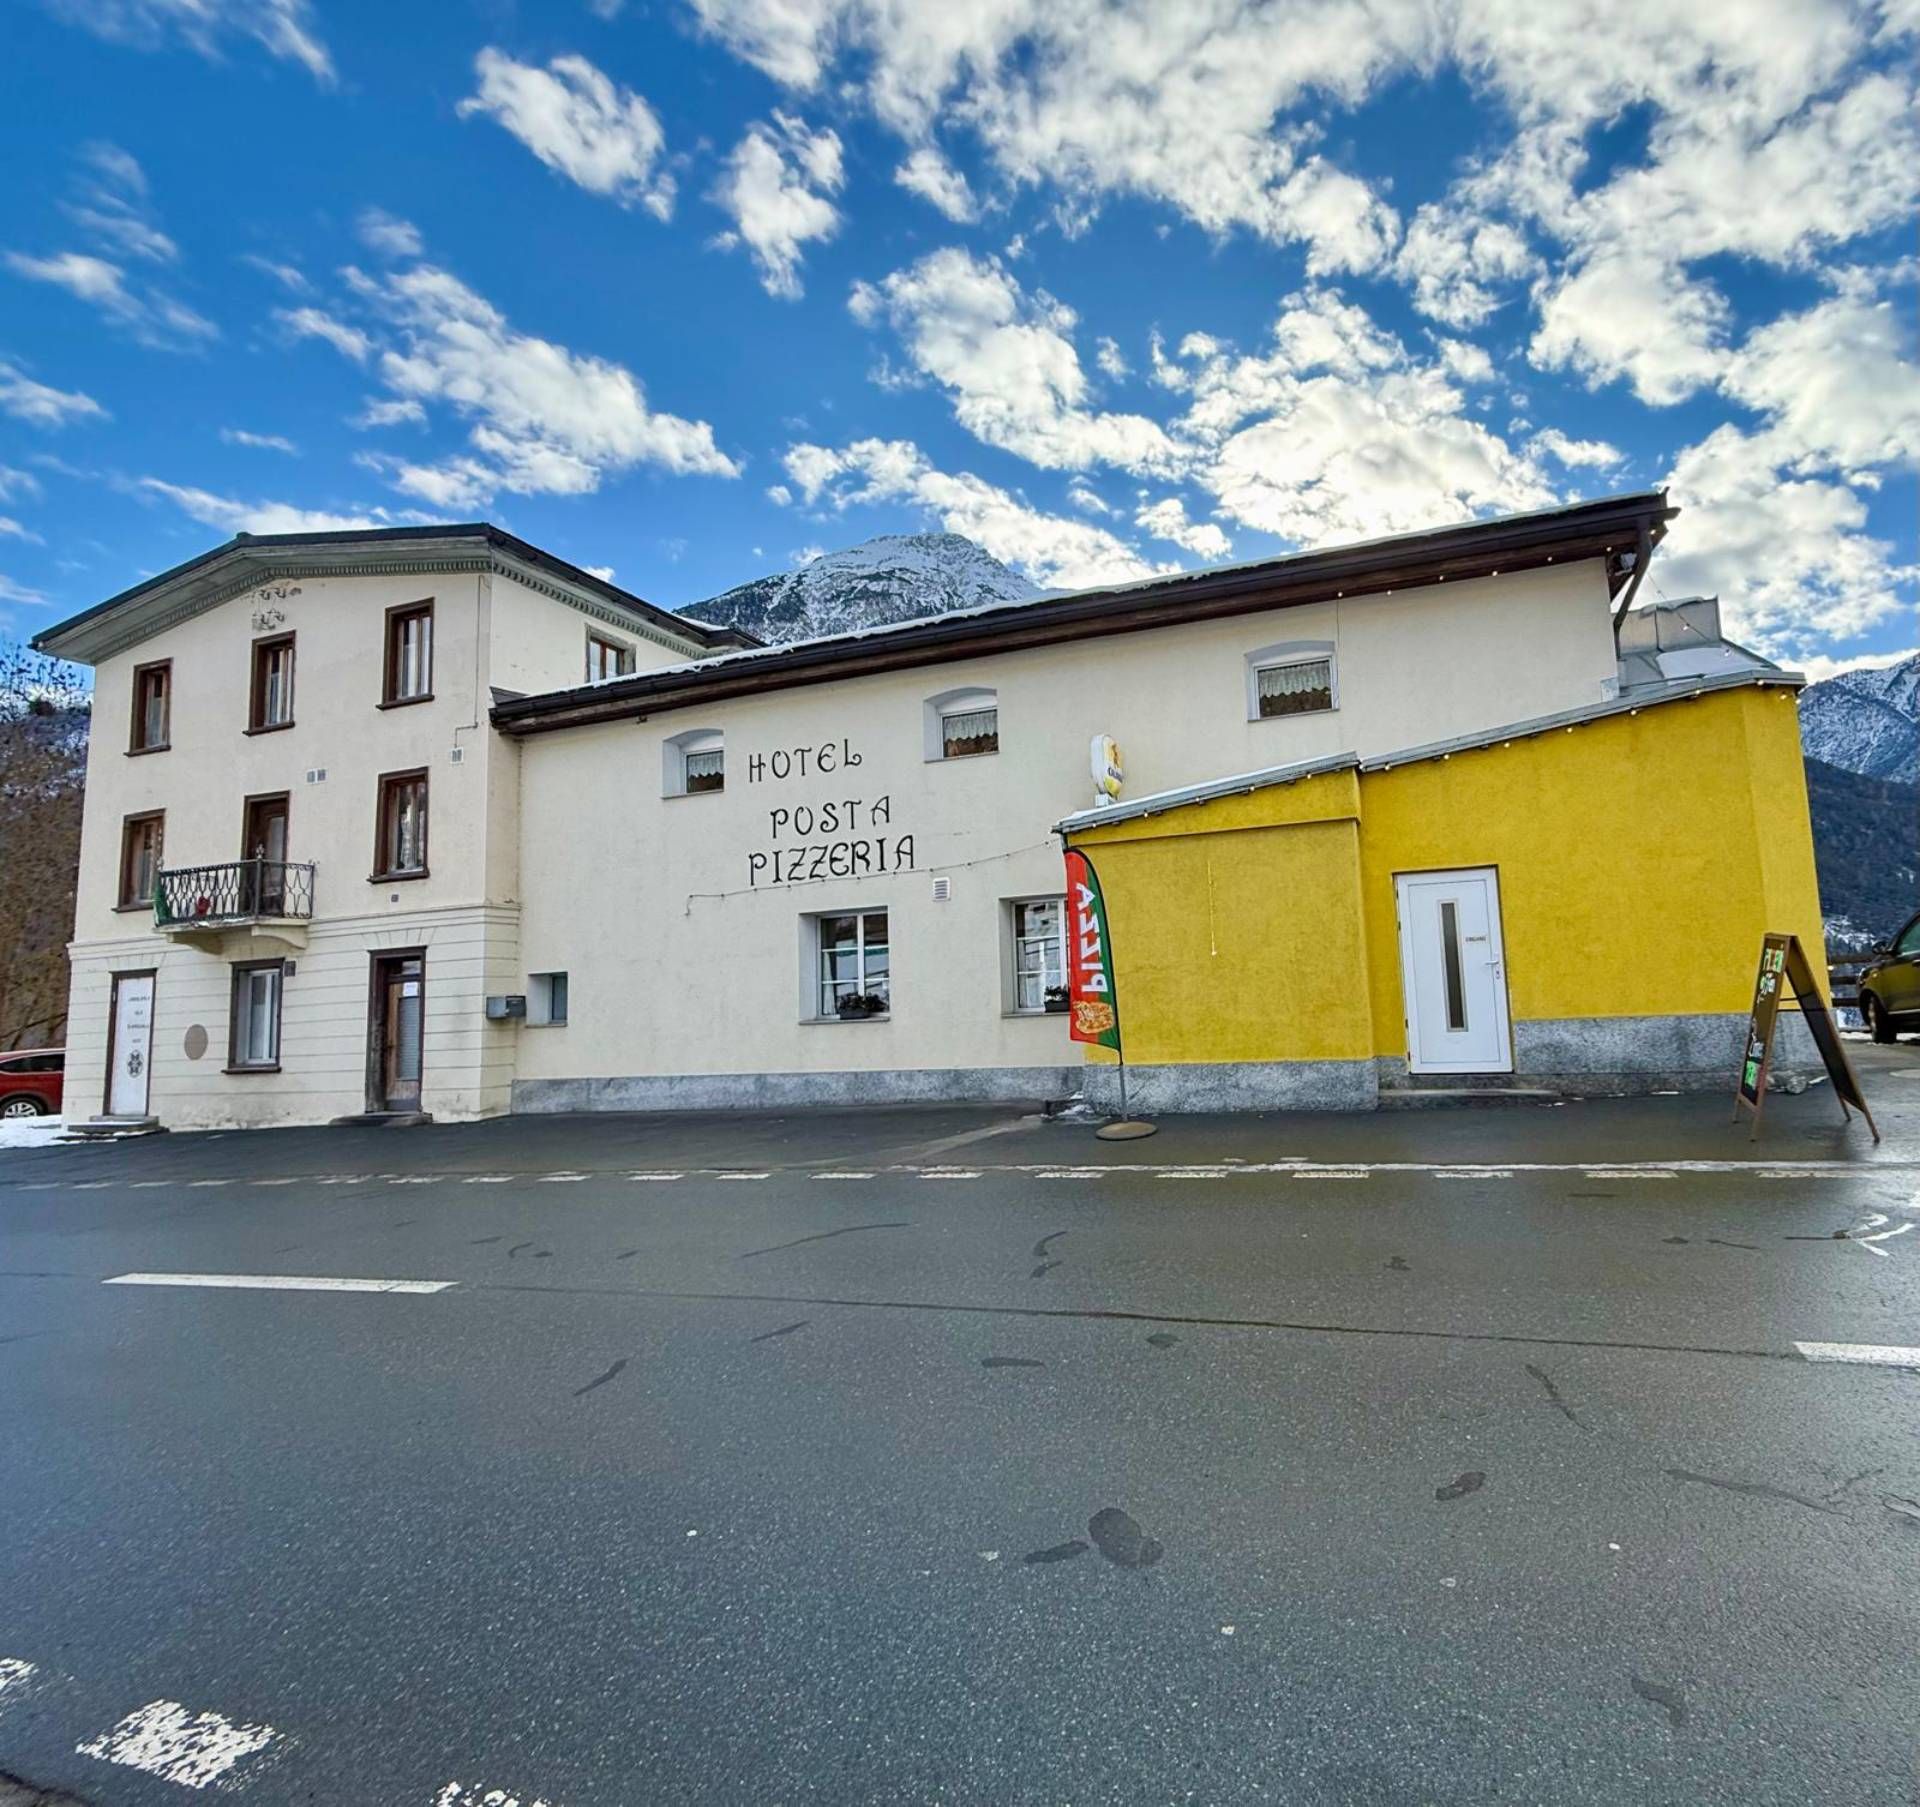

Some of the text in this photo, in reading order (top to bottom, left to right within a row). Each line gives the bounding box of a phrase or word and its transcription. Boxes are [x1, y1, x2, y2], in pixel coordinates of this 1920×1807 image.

[749, 738, 862, 783] HOTEL
[770, 795, 890, 839] POSTA
[748, 834, 914, 886] PIZZERIA
